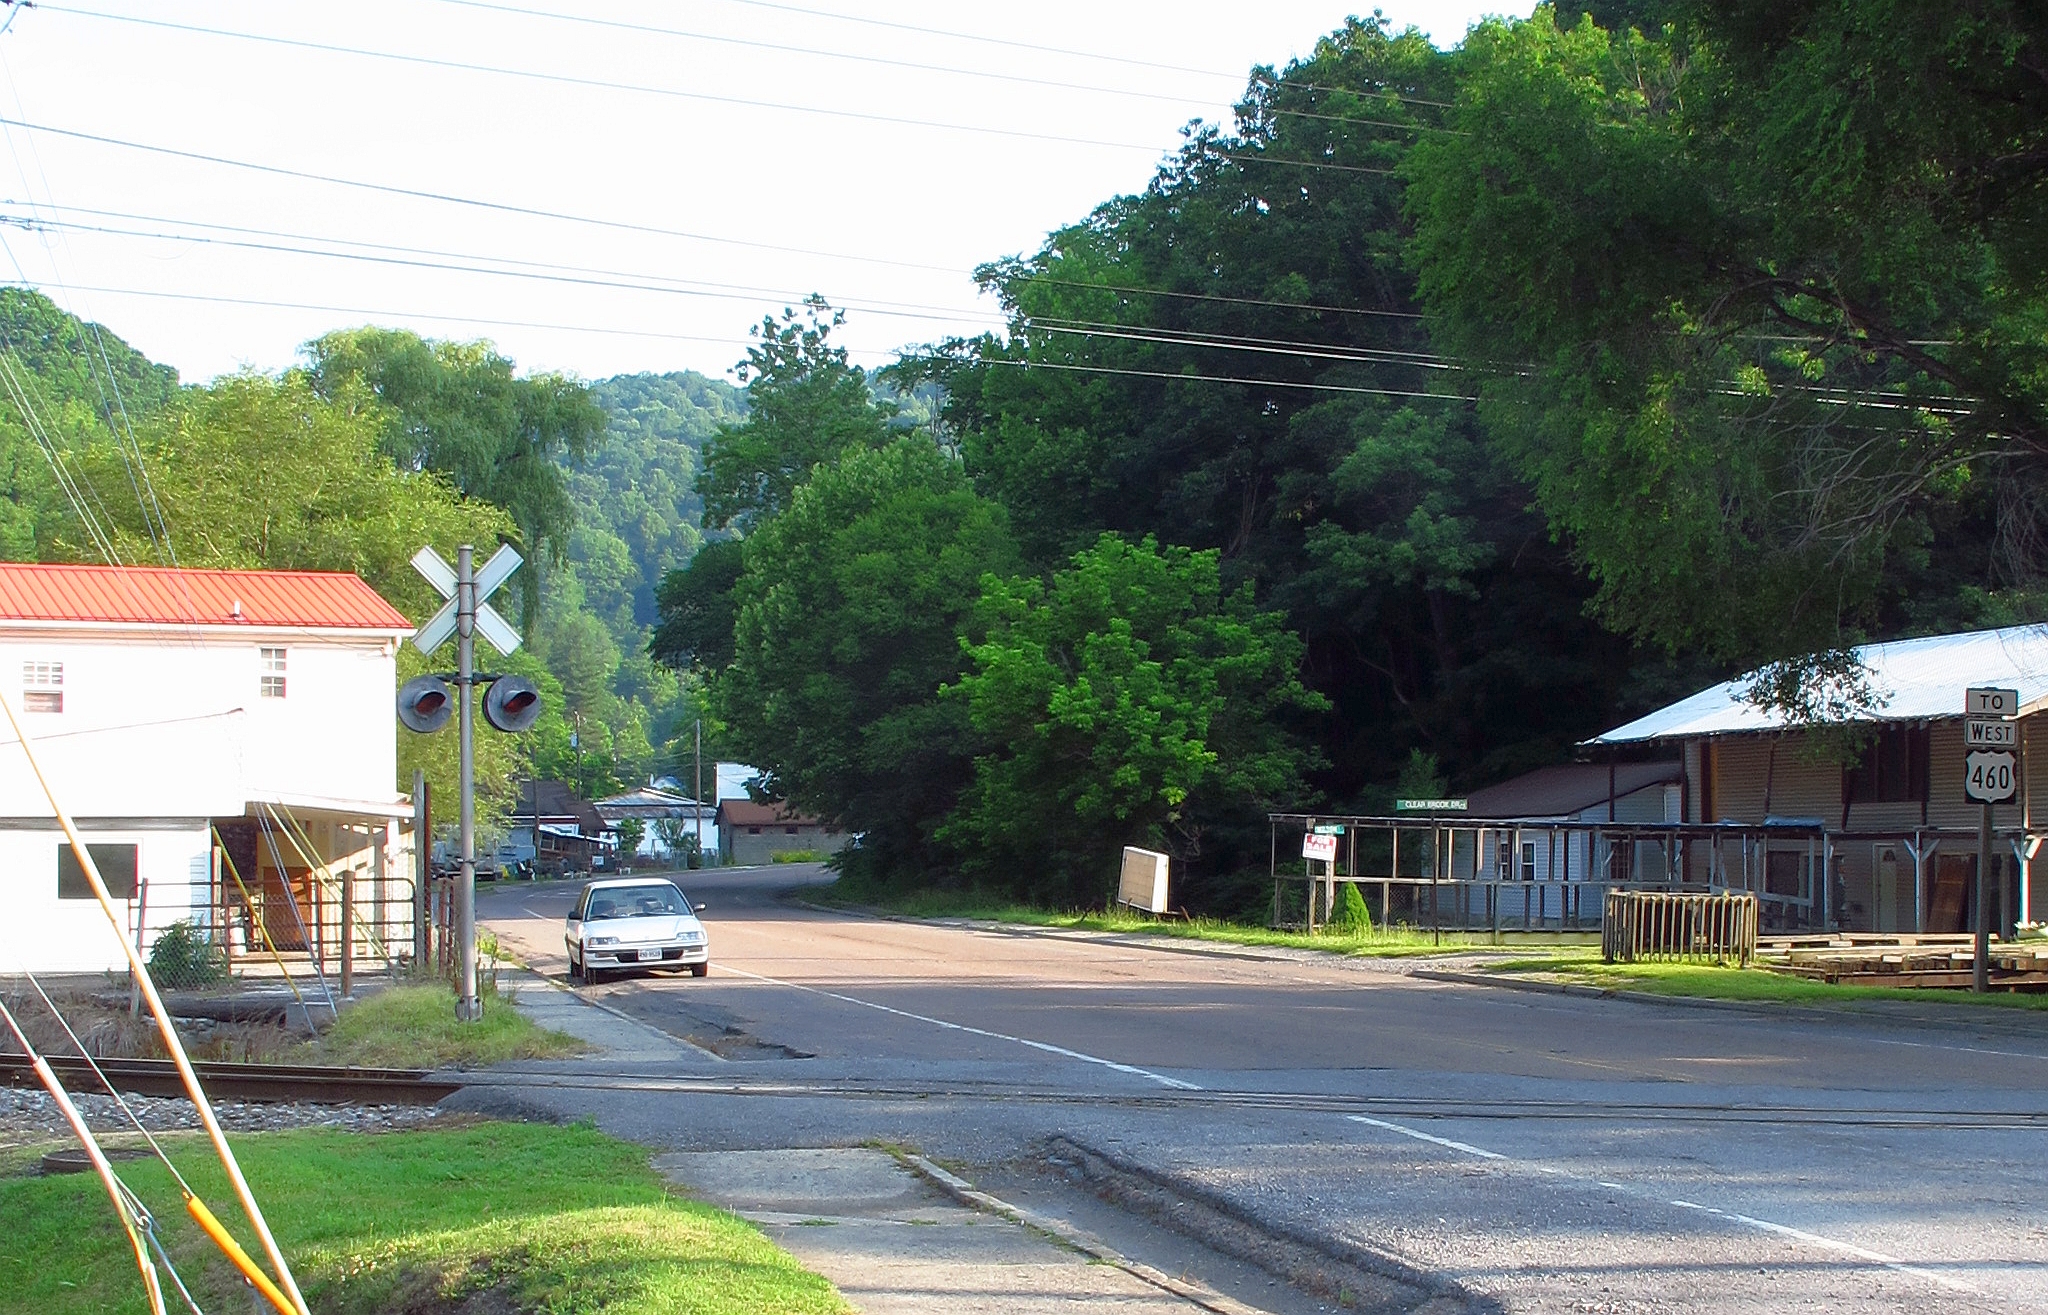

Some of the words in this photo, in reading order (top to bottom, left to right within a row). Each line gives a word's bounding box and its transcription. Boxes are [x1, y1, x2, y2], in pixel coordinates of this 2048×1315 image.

[1979, 694, 2003, 710] TO
[1971, 722, 2012, 741] WEST
[1971, 764, 2009, 790] 460
[1404, 800, 1426, 809] CLEAR
[1427, 800, 1450, 809] BROOK
[1311, 835, 1330, 846] FOR
[1306, 842, 1334, 853] SALE
